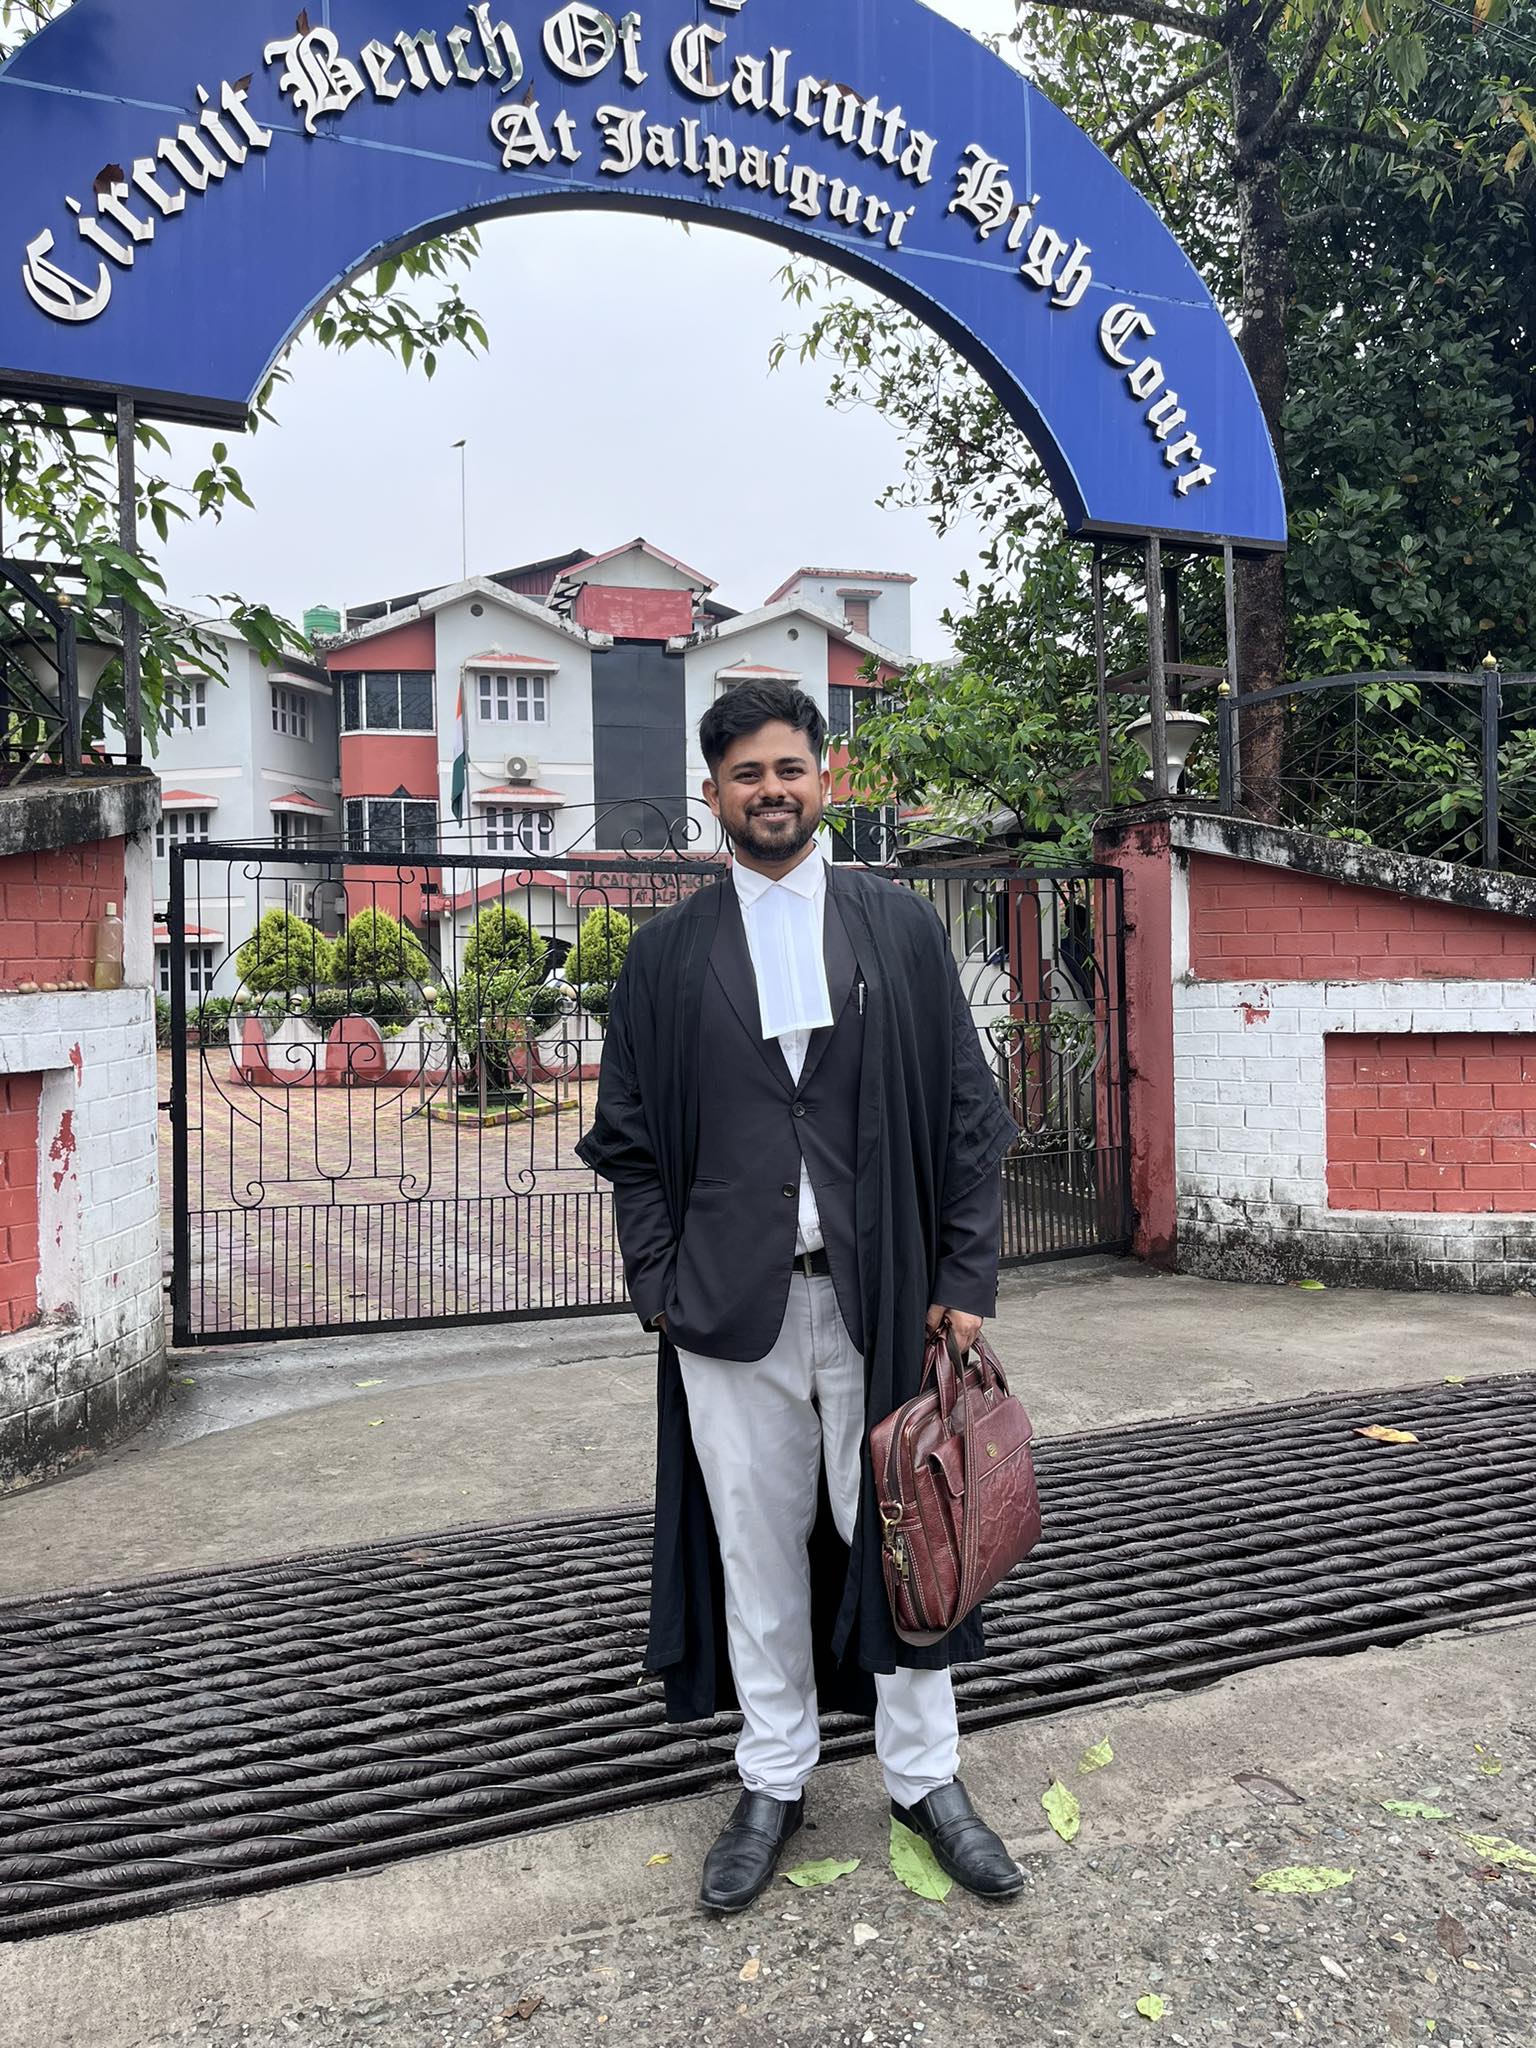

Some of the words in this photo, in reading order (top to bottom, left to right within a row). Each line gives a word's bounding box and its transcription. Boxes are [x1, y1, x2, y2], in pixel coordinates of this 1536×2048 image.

[22, 81, 273, 322] Circuit
[264, 2, 525, 134] Bench
[543, 1, 648, 85] Of
[670, 23, 938, 184] Calcutta
[948, 143, 1093, 307] High
[1100, 303, 1217, 497] Court
[491, 101, 581, 169] At
[595, 105, 916, 248] Jalpaiguri
